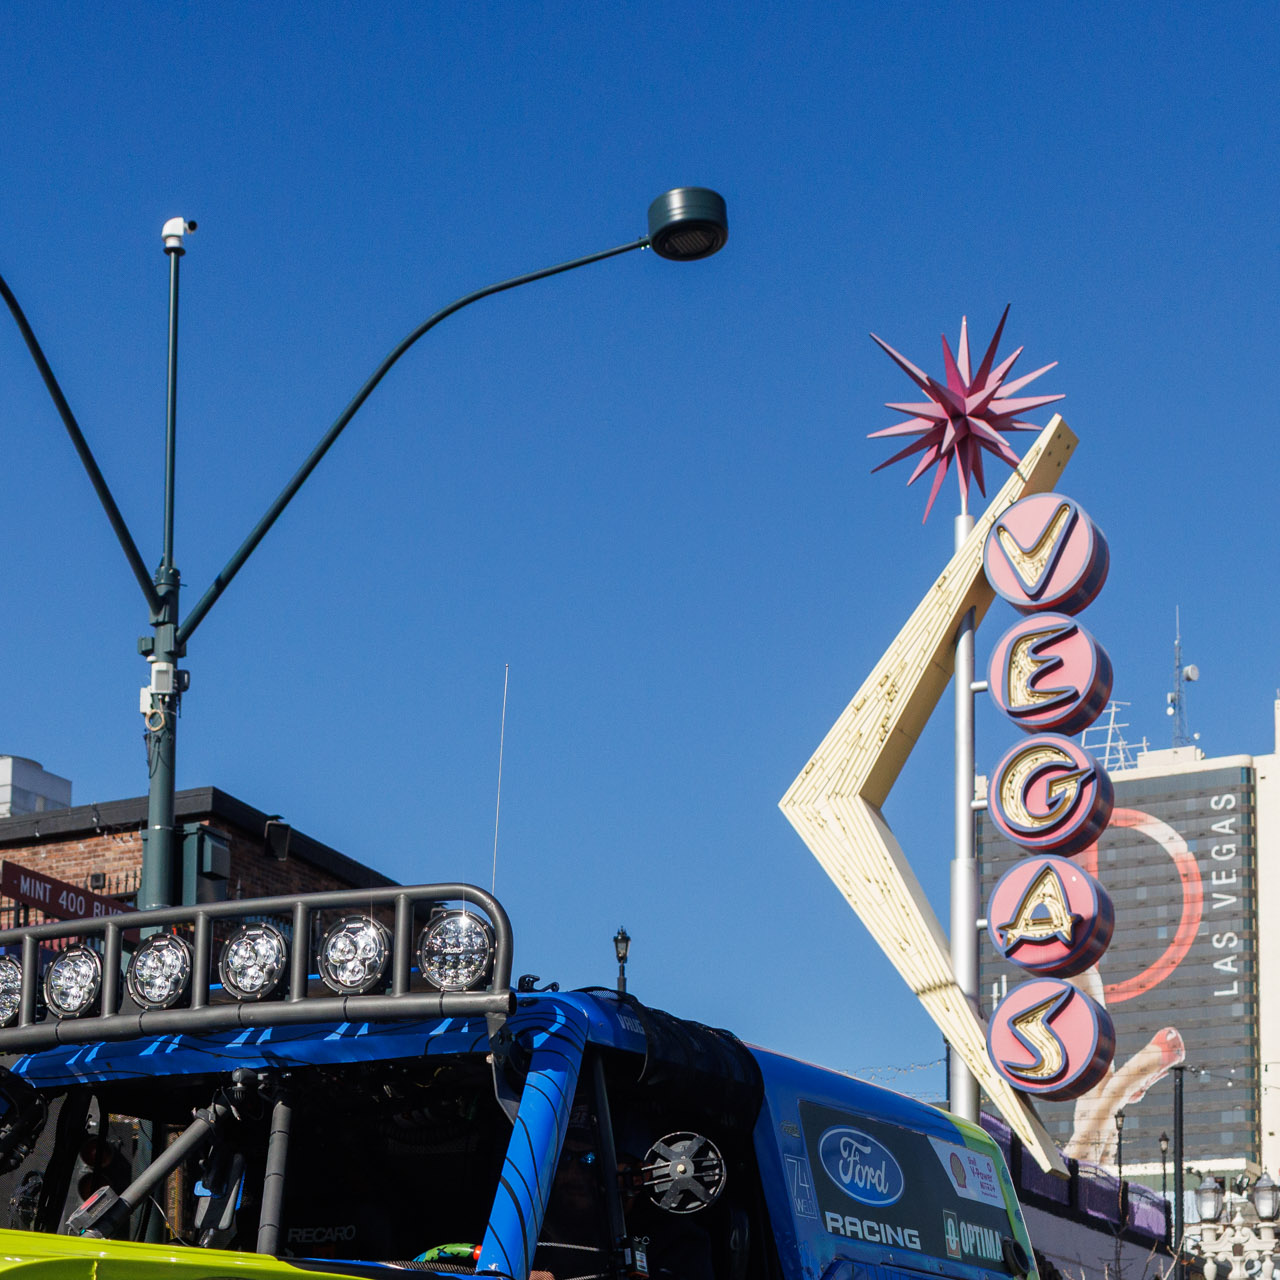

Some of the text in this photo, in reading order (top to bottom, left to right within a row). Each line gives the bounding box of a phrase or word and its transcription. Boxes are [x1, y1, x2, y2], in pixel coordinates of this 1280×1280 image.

[996, 500, 1096, 1086] VEGAS
[20, 874, 52, 904] MINT
[58, 890, 86, 916] 400
[1210, 793, 1239, 998] LAS VEGAS
[839, 1136, 889, 1194] Ford
[287, 1225, 356, 1243] RECARO
[825, 1211, 921, 1250] RACING
[960, 1221, 1004, 1261] OPTIMA
